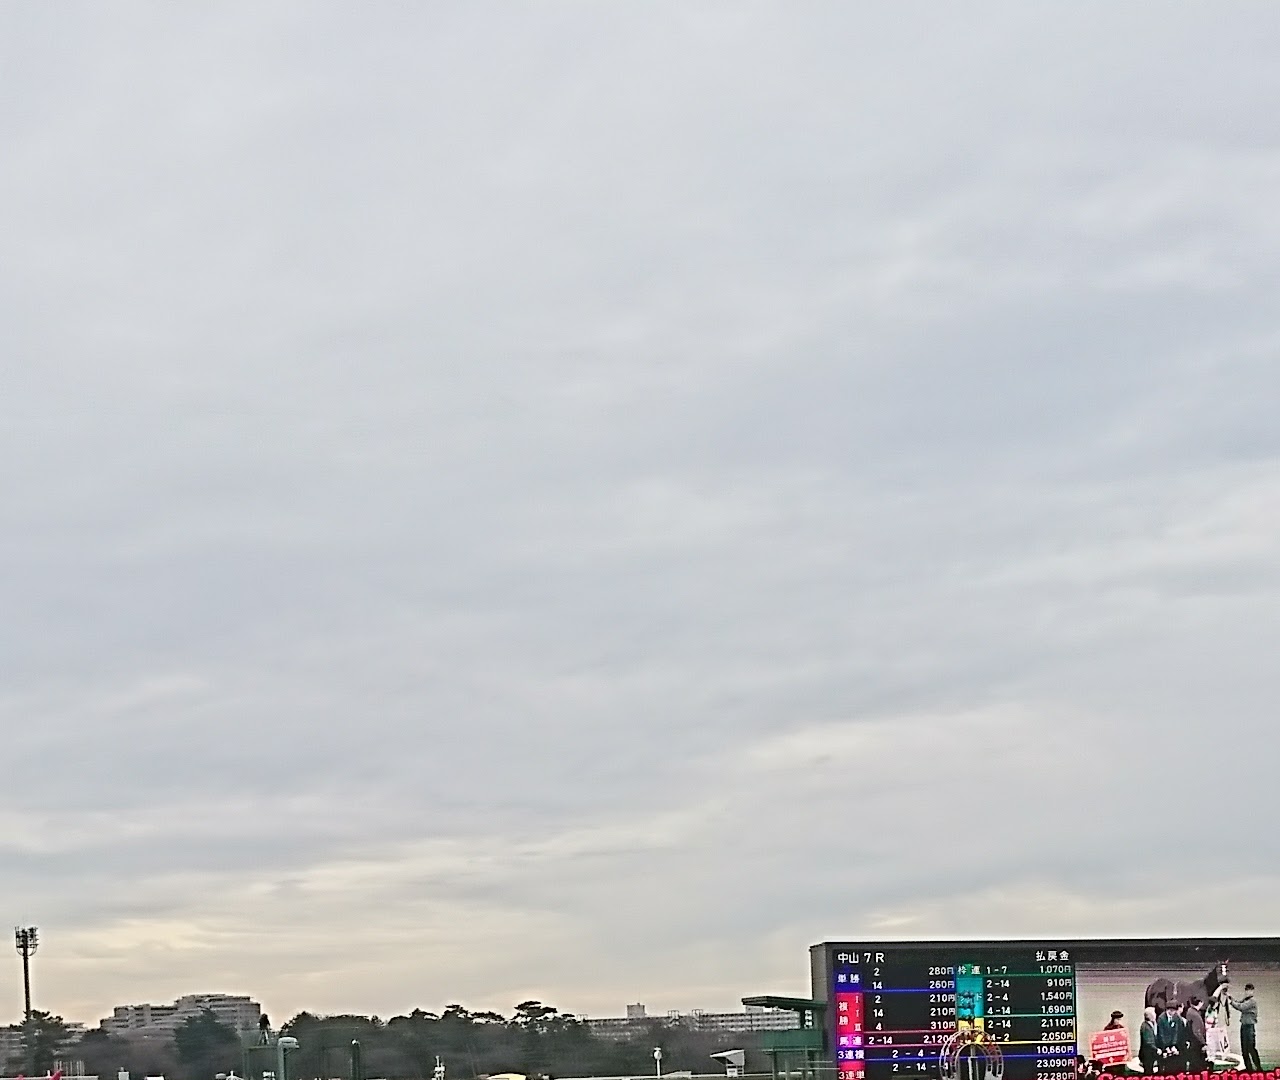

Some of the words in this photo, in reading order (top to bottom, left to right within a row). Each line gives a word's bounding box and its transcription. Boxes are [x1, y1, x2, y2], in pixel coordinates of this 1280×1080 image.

[838, 952, 859, 963] 中山
[1036, 951, 1069, 961] 払戻金
[874, 968, 880, 976] 2
[929, 967, 954, 976] 280円
[1047, 978, 1072, 987] 910円
[875, 995, 881, 1003] 2
[929, 994, 956, 1002] 210円
[873, 1009, 884, 1017] 14
[930, 1008, 956, 1016] 210円
[930, 1021, 956, 1029] 310円
